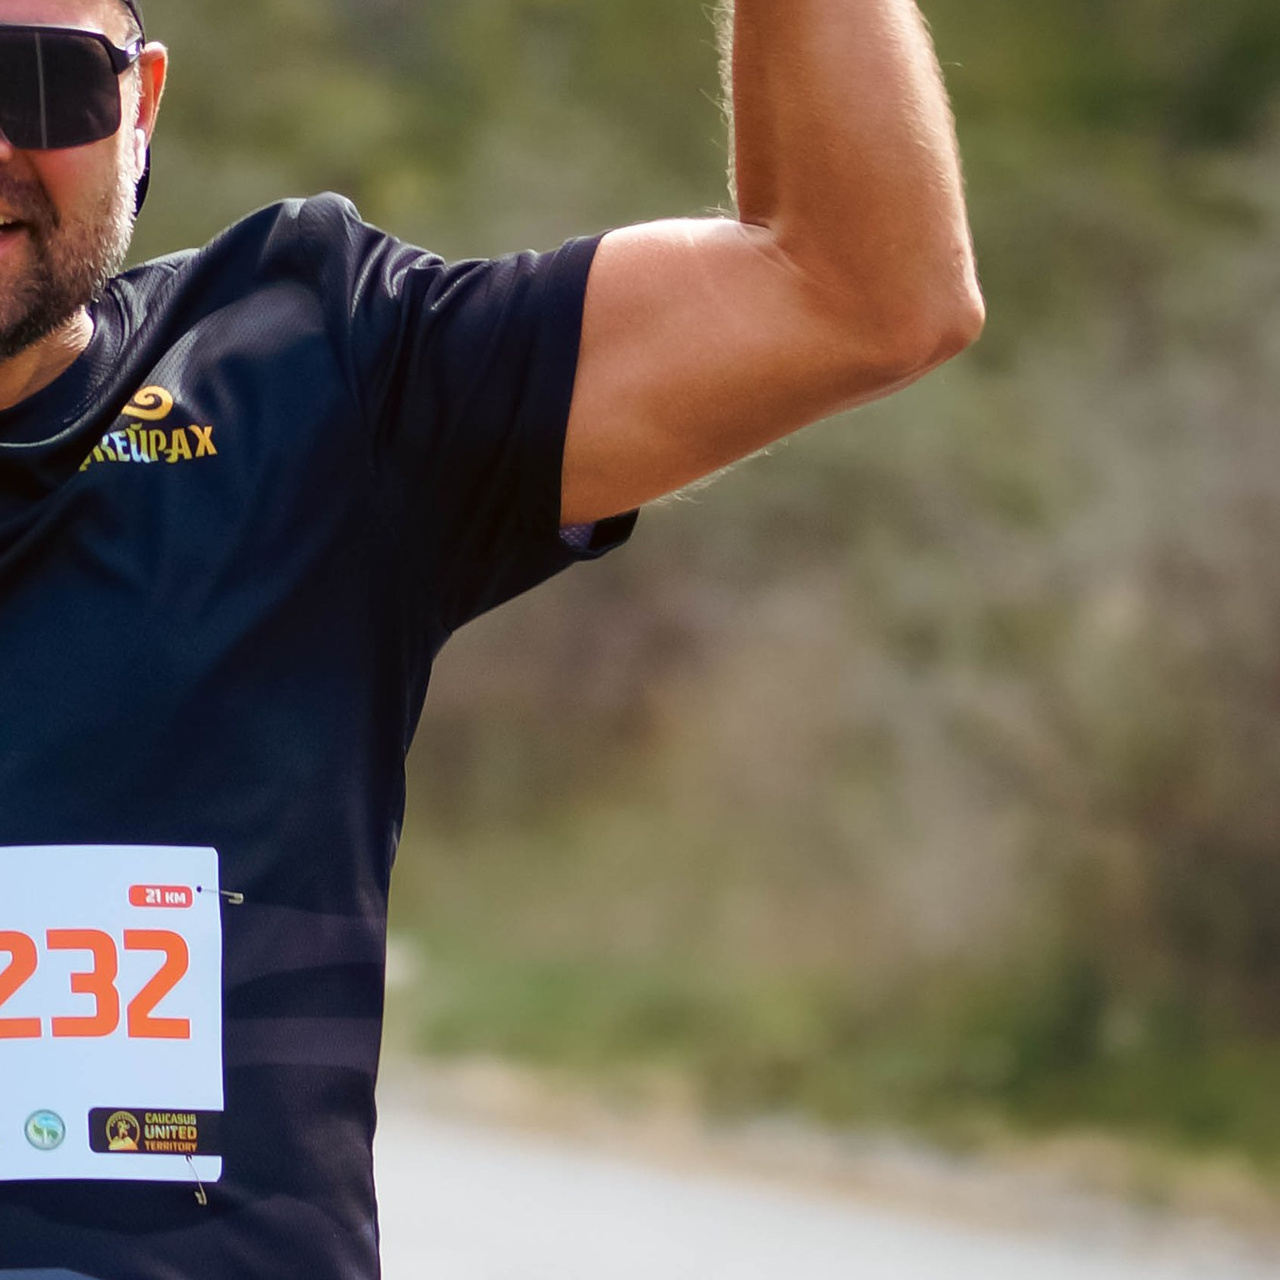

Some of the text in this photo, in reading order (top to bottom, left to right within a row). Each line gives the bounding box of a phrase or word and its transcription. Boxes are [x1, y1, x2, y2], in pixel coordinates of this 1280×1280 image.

[145, 887, 161, 904] 21
[144, 1112, 197, 1126] CAUCASUS
[144, 1125, 198, 1140] UNITED
[144, 1140, 198, 1153] TERRITORY
